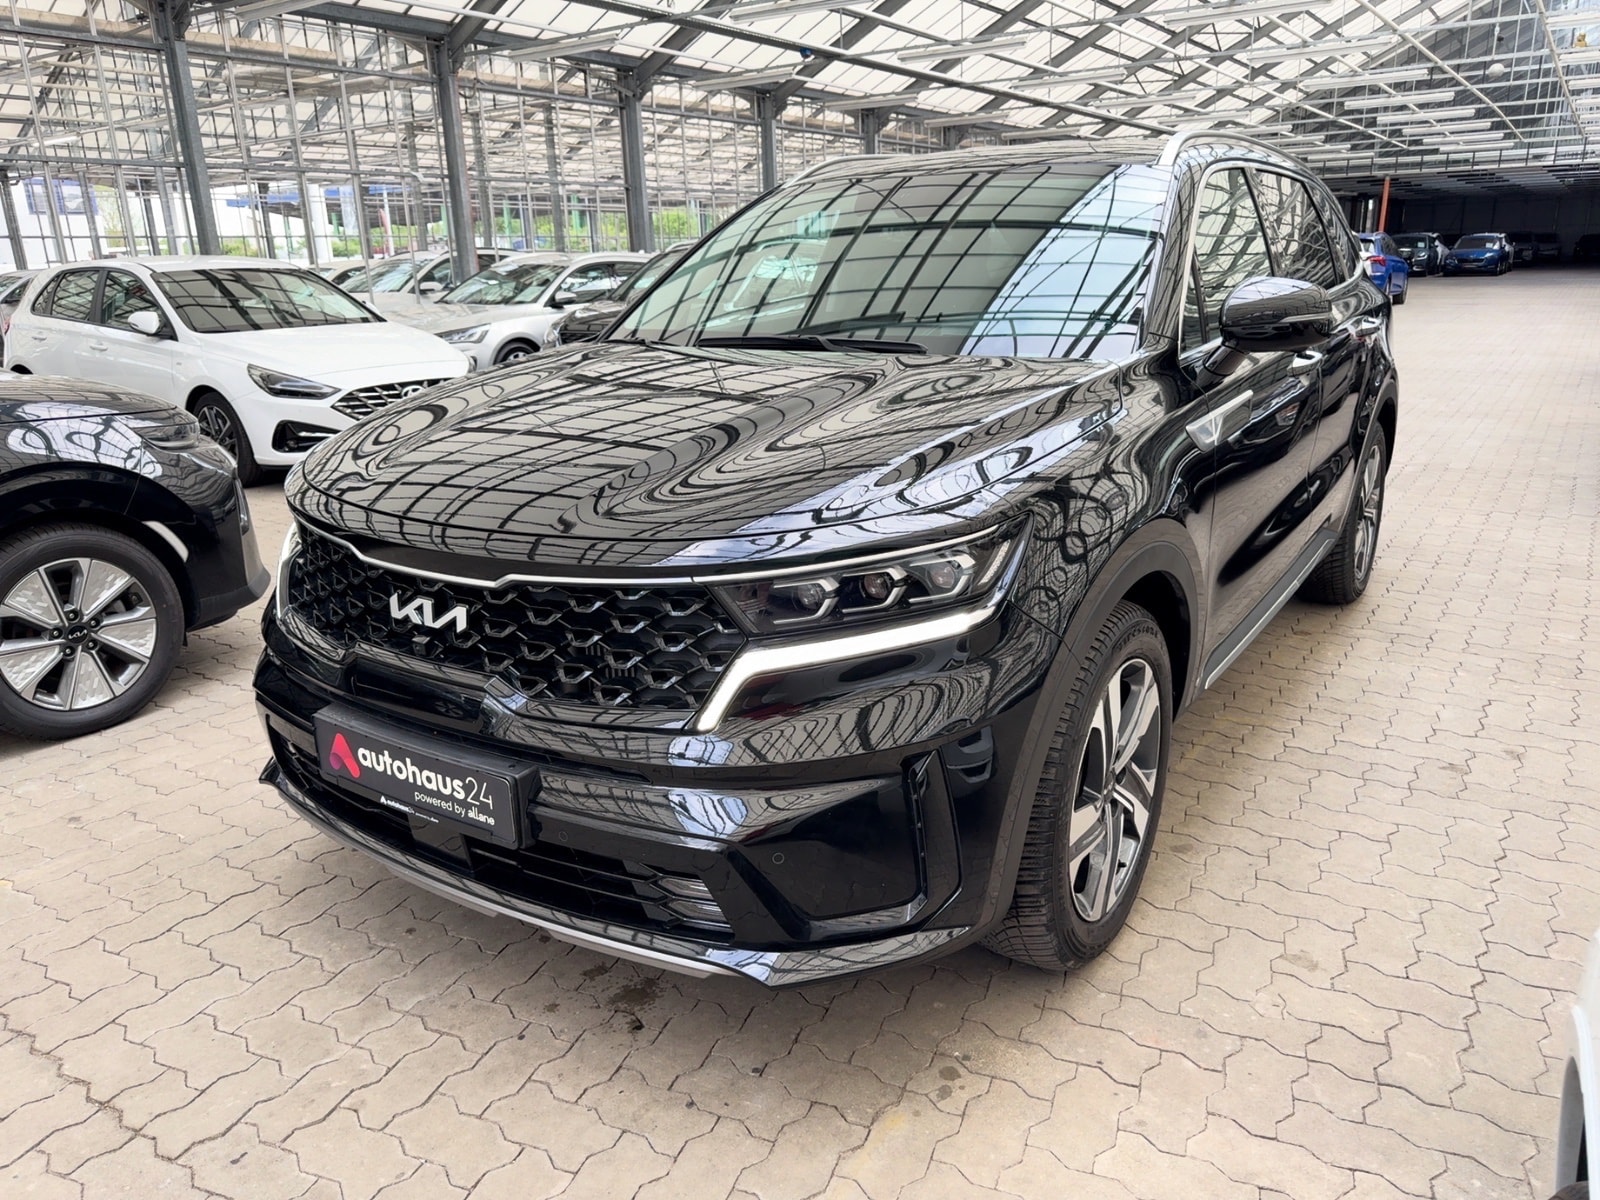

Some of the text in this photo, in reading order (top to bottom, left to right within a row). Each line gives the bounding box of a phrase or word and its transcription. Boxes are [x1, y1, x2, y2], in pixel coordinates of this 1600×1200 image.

[390, 592, 468, 634] KIA
[358, 747, 493, 809] autohaus24
[415, 791, 452, 811] powered
[455, 802, 466, 817] by
[468, 808, 495, 825] allane
